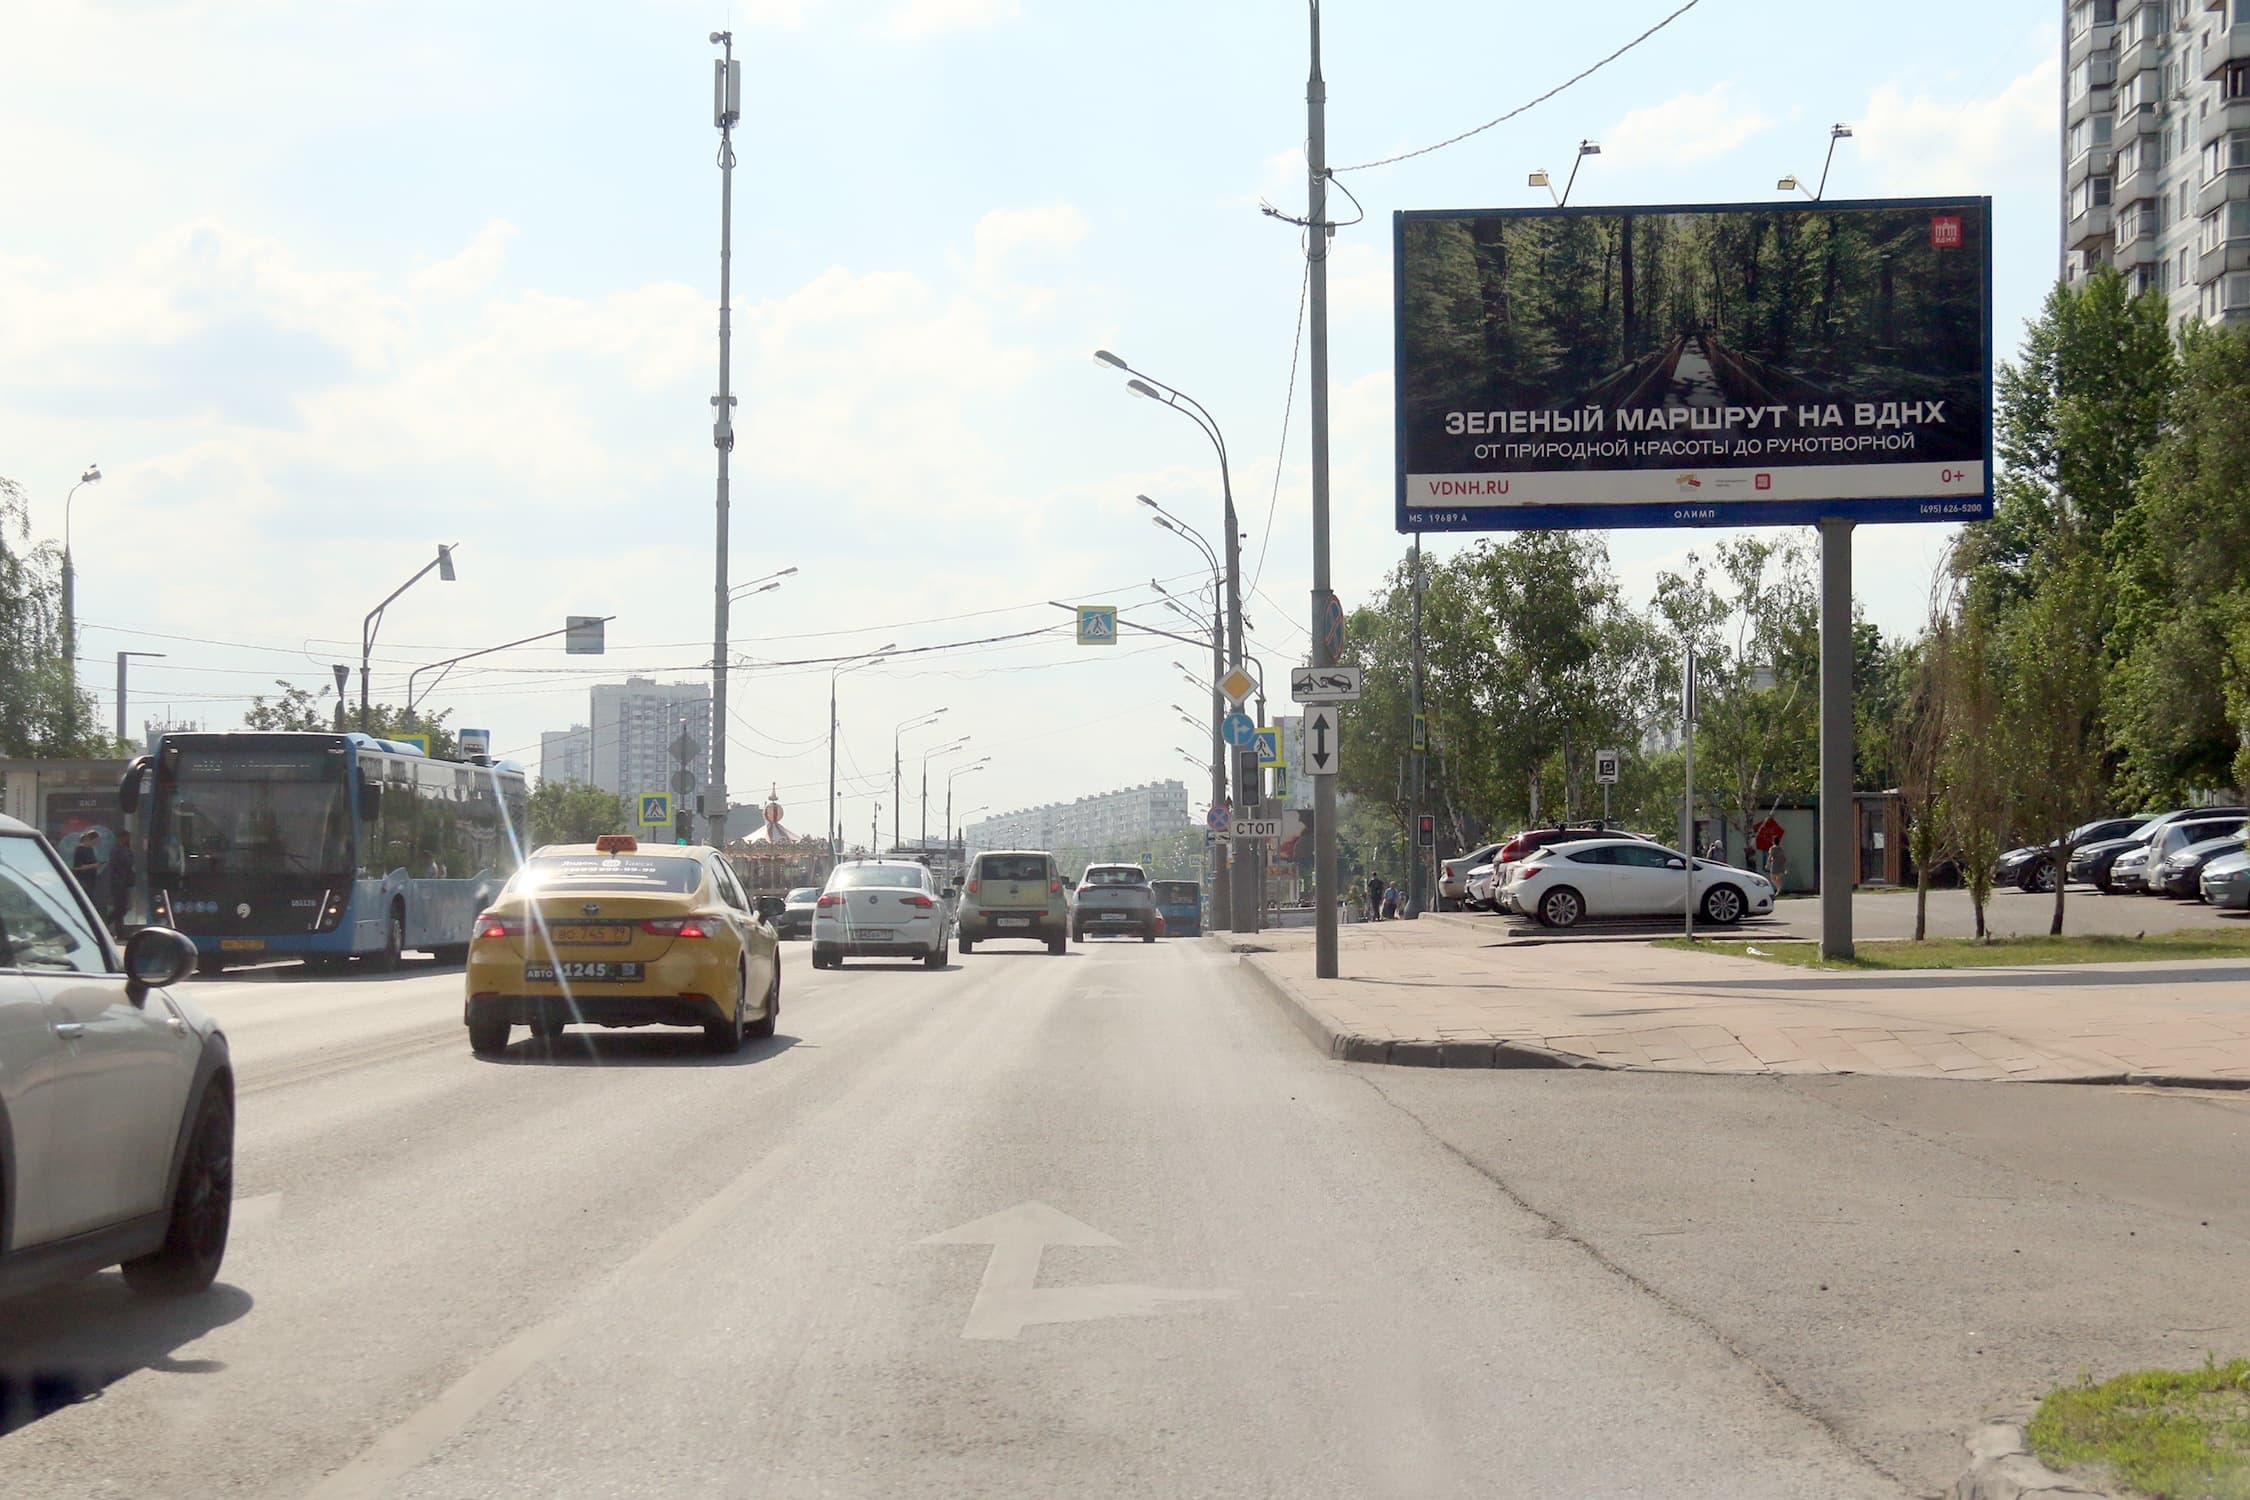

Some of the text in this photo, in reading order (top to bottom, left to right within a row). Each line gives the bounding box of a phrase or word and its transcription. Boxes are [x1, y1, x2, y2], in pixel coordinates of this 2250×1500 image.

[1444, 400, 1947, 435] ЗЕЛЕНЫЙ МАРШРУТ НА ВДНХ
[1474, 432, 1916, 460] ОТ ПРИРОДНОЙ КРАСОТЫ ДО РУКОТВОРНОЙ
[1941, 468, 1966, 483] 0+
[1429, 480, 1510, 496] VDNH.RU
[1673, 509, 1716, 520] ОЛИМП
[1920, 503, 1983, 515] (495) 626-5200
[1408, 512, 1469, 524] MS 19689 A
[1236, 822, 1276, 835] СТОП
[526, 969, 554, 978] АВТО
